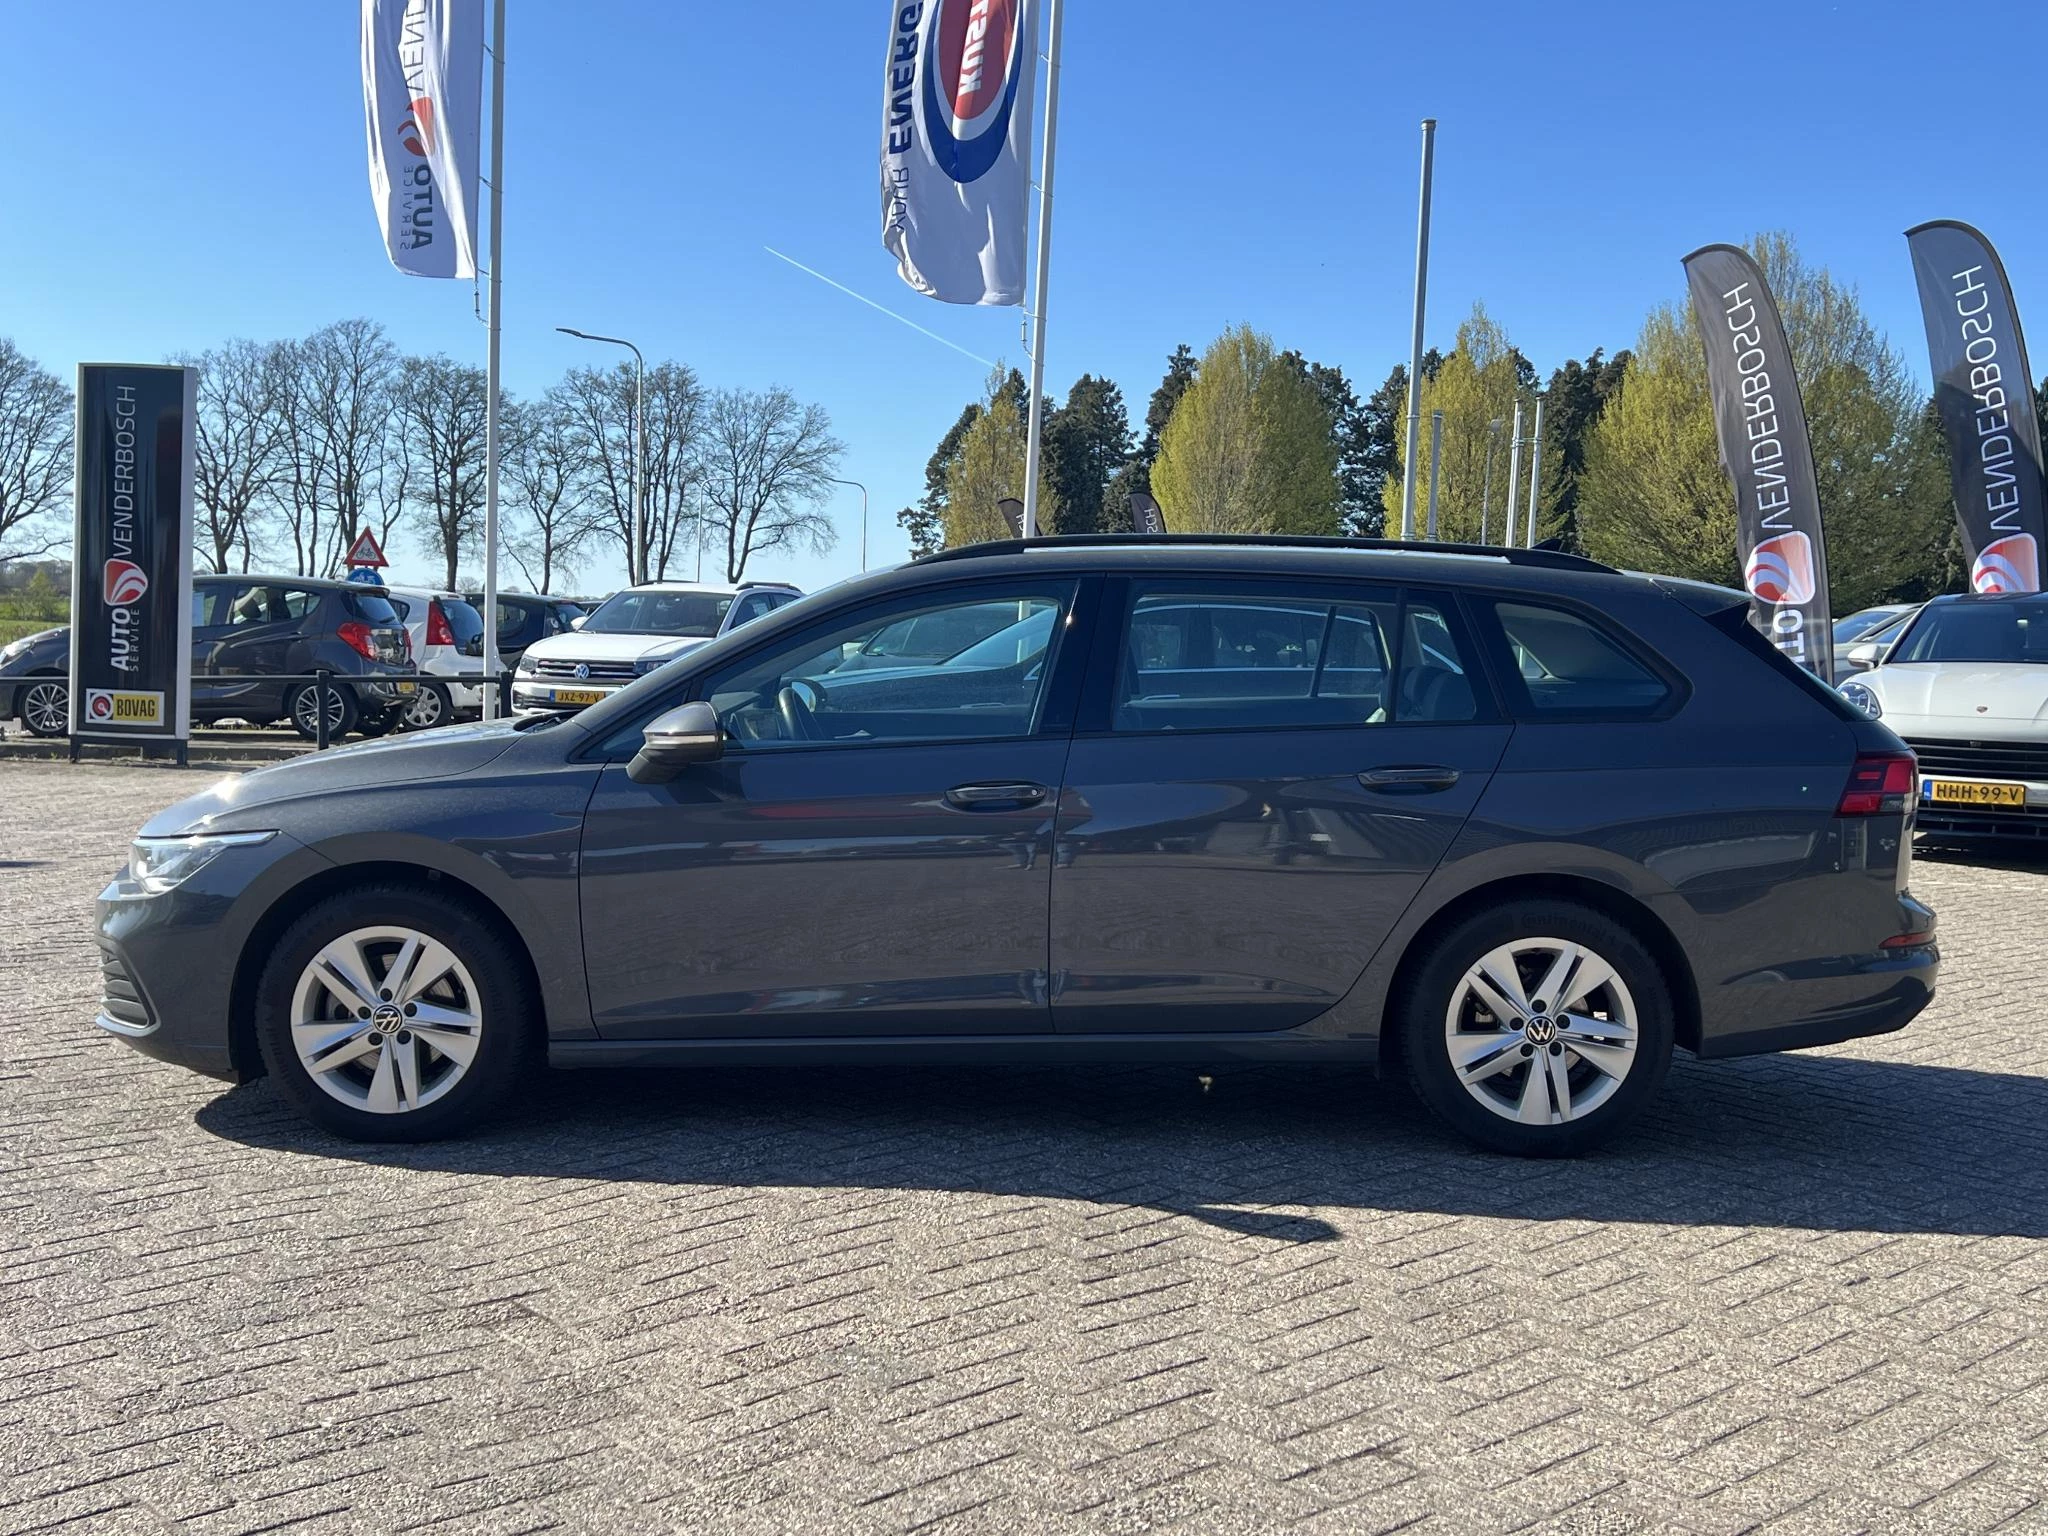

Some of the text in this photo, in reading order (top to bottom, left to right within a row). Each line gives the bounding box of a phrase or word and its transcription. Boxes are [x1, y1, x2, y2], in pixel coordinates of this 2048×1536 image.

[111, 386, 136, 672] AUTO VENDERBOSCH
[129, 608, 140, 672] SERVICE
[116, 699, 155, 717] BOVAG
[1936, 784, 2018, 801] HHH-99-V
